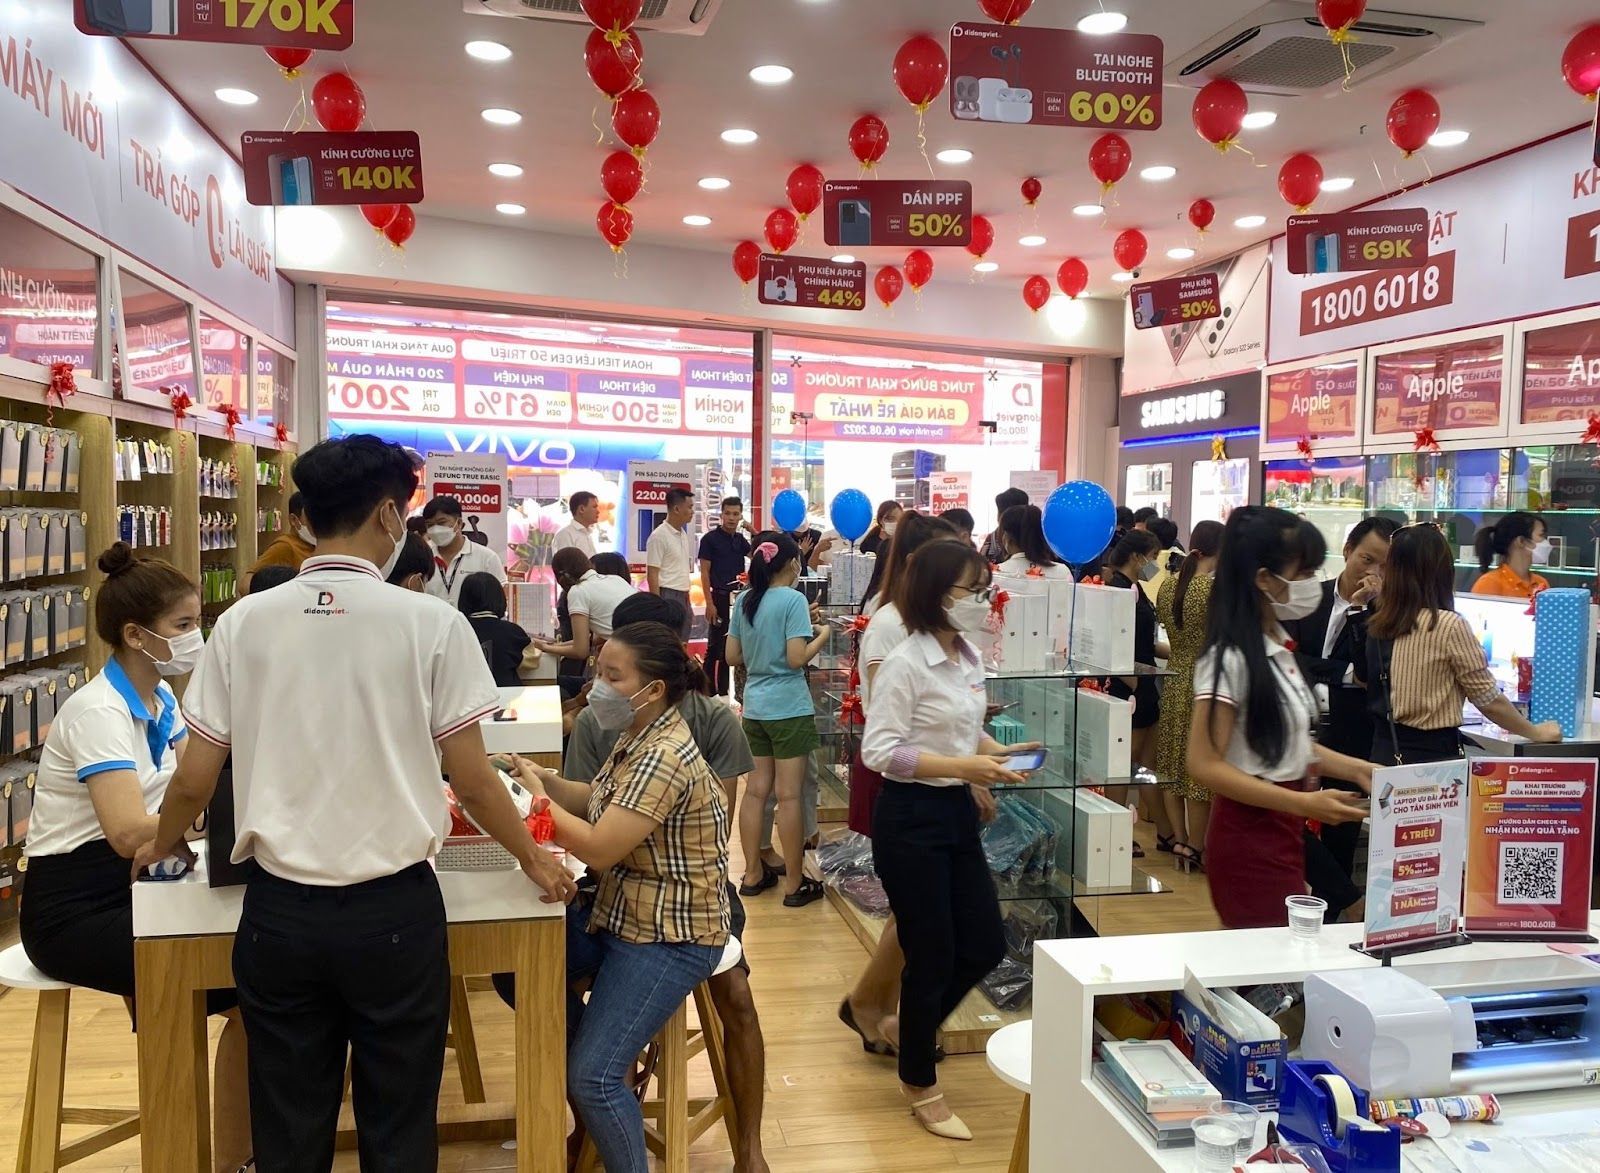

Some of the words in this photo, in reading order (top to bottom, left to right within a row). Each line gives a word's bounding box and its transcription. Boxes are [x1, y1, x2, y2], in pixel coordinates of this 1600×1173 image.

[964, 29, 1000, 38] didongviet
[1094, 53, 1114, 66] TAI
[1117, 55, 1153, 68] NGHE
[1076, 68, 1153, 84] BLUETOOTH
[1069, 90, 1155, 125] 60%
[60, 79, 105, 160] MỚI
[321, 148, 348, 159] KÍNH
[351, 148, 390, 159] CƯỜNG
[392, 148, 415, 161] LỰC
[130, 138, 167, 207] TRẢ
[170, 174, 200, 227] GÓP
[337, 166, 416, 190] 140K
[902, 190, 932, 205] DÁN
[936, 193, 963, 205] PPF
[909, 213, 963, 237] 50%
[1347, 226, 1370, 236] KÍNH
[1371, 225, 1403, 235] CƯỜNG
[1405, 224, 1423, 233] LỰC
[1363, 239, 1412, 260] 69K
[799, 266, 815, 275] PHỤ
[817, 266, 836, 277] KIỆN
[837, 269, 862, 277] APPLE
[804, 277, 830, 286] CHÍNH
[1181, 281, 1196, 290] PHỤ
[1196, 277, 1212, 288] KIỆN
[818, 289, 862, 307] 44%
[1179, 287, 1213, 299] SAMSUNG
[1311, 284, 1367, 327] 1800
[1373, 265, 1439, 313] 6018
[1181, 299, 1217, 318] 30%
[1247, 341, 1261, 351] Series
[1407, 374, 1464, 402] Apple
[1141, 389, 1226, 429] SAMSUNG
[1291, 390, 1331, 417] Apple
[304, 607, 345, 615] didongviet
[1393, 806, 1408, 814] CHO
[1426, 802, 1441, 810] SINH
[1394, 798, 1417, 806] LAPTOP
[1409, 827, 1436, 840] TRIỆU
[1485, 826, 1511, 836] NHẬN
[1398, 865, 1415, 876] 5%
[1520, 920, 1556, 928] 1800.6018
